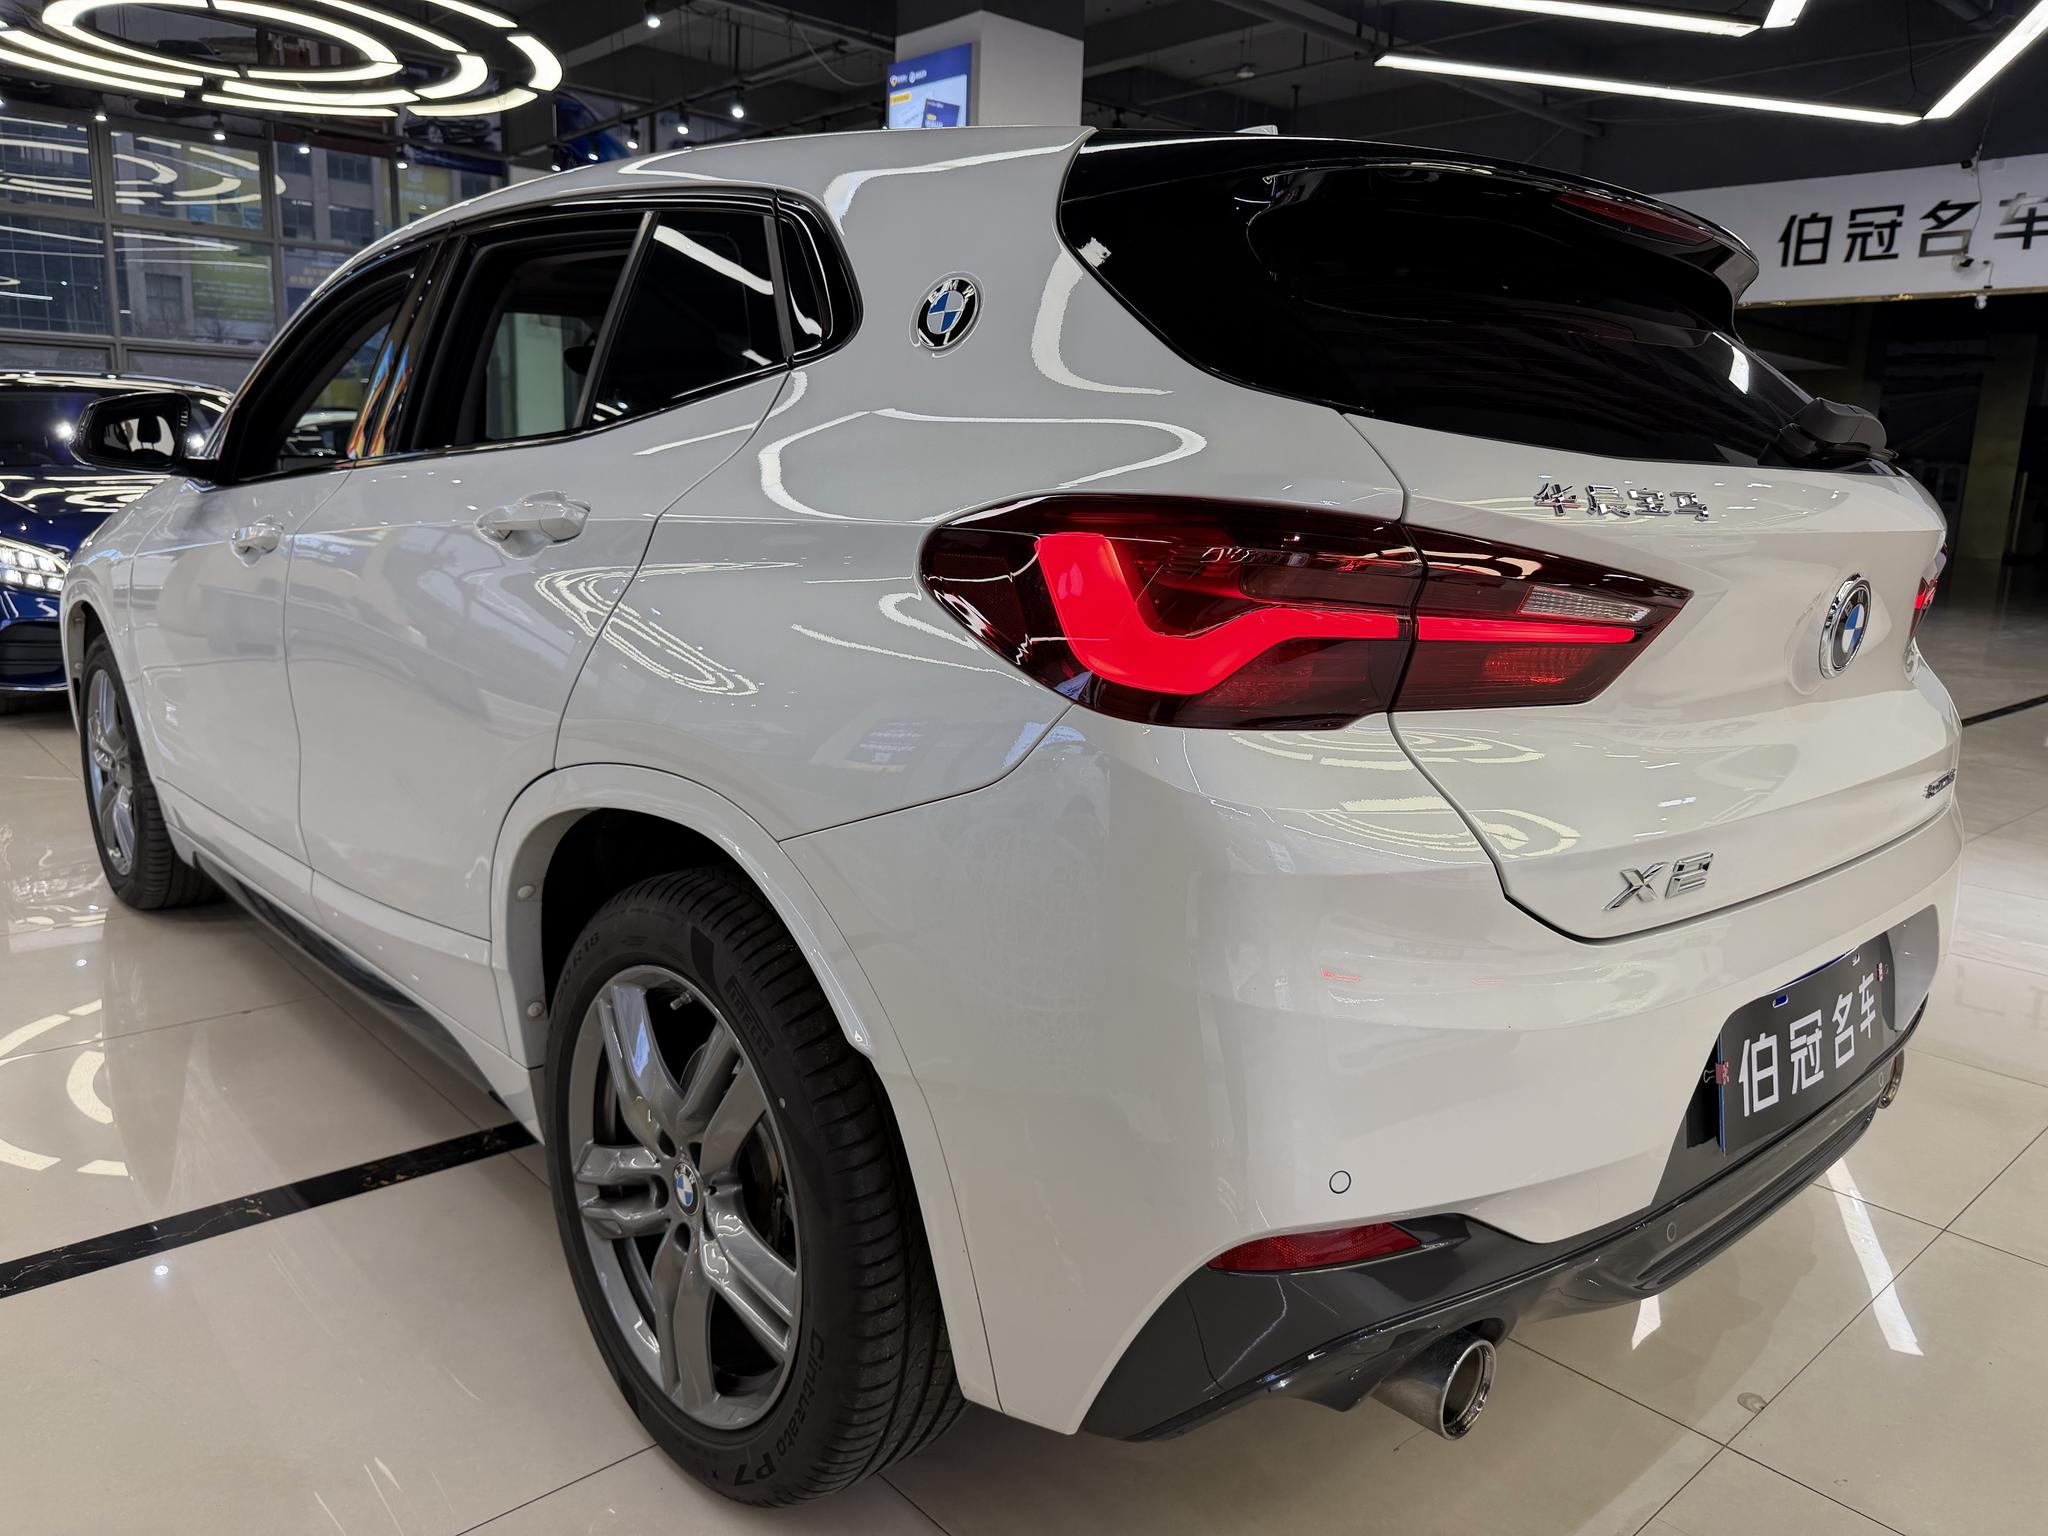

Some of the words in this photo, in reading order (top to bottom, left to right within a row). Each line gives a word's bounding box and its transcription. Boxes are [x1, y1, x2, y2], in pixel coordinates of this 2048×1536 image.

[1778, 191, 2048, 268] 伯冠名车
[1533, 482, 1711, 522] 华晨宝马
[1601, 851, 1714, 912] X2
[1738, 971, 1877, 1118] 伯冠名车
[777, 1327, 825, 1457] Cinturato
[734, 1451, 777, 1487] P7
